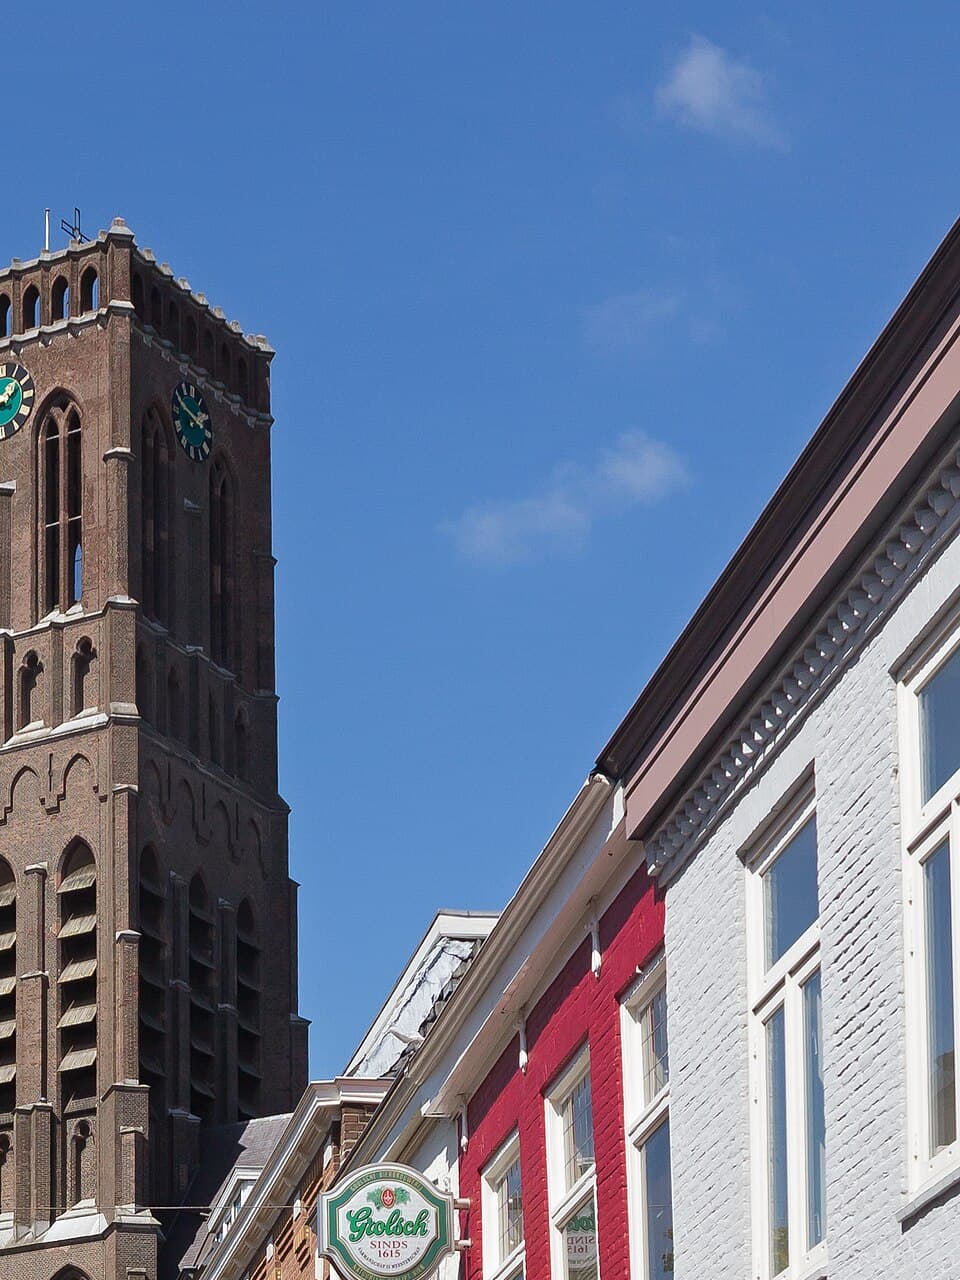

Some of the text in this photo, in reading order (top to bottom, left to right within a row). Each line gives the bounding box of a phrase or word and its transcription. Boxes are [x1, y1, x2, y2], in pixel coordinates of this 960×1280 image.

[346, 1206, 430, 1242] Grolsch
[370, 1240, 408, 1249] SINDS
[377, 1250, 401, 1258] 1615
